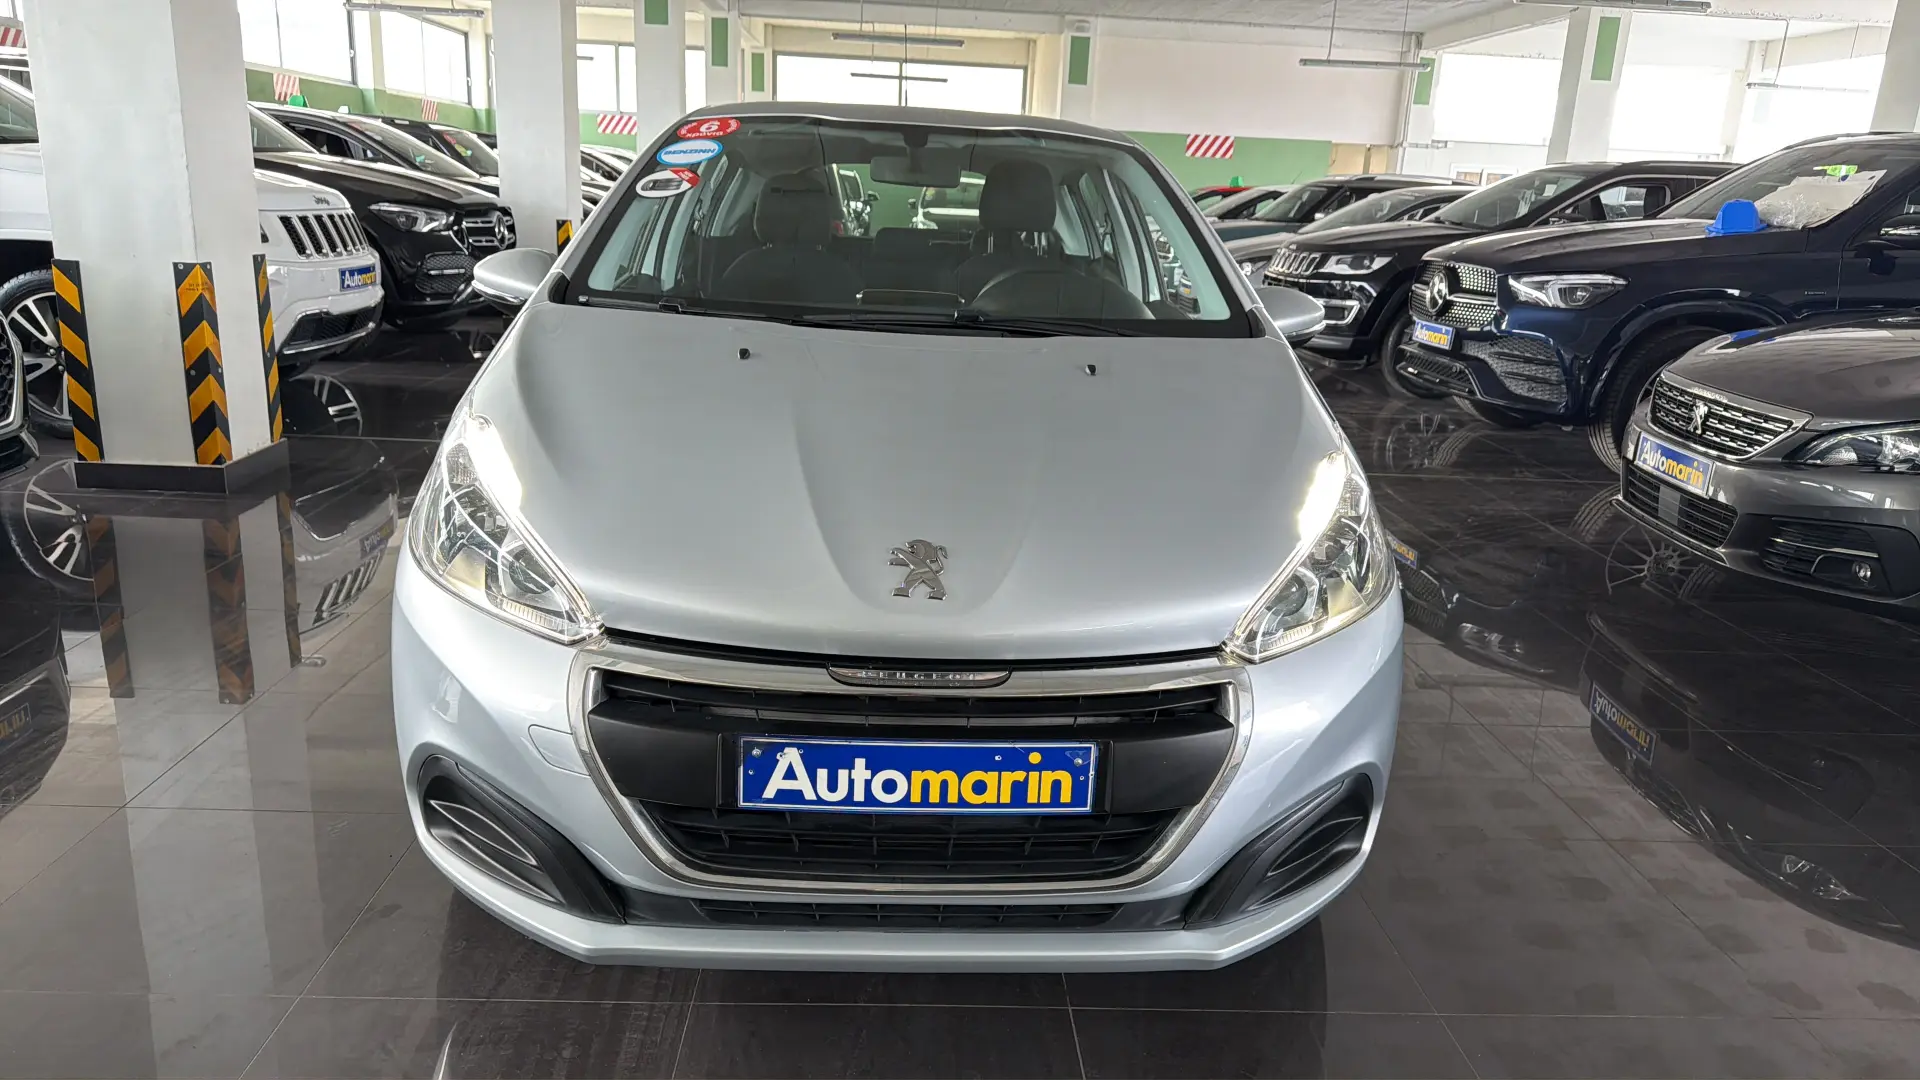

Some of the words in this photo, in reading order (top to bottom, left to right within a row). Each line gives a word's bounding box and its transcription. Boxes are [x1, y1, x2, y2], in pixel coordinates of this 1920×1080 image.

[699, 120, 721, 132] 6
[1640, 441, 1705, 488] Automarin
[761, 747, 1073, 804] Automarin
